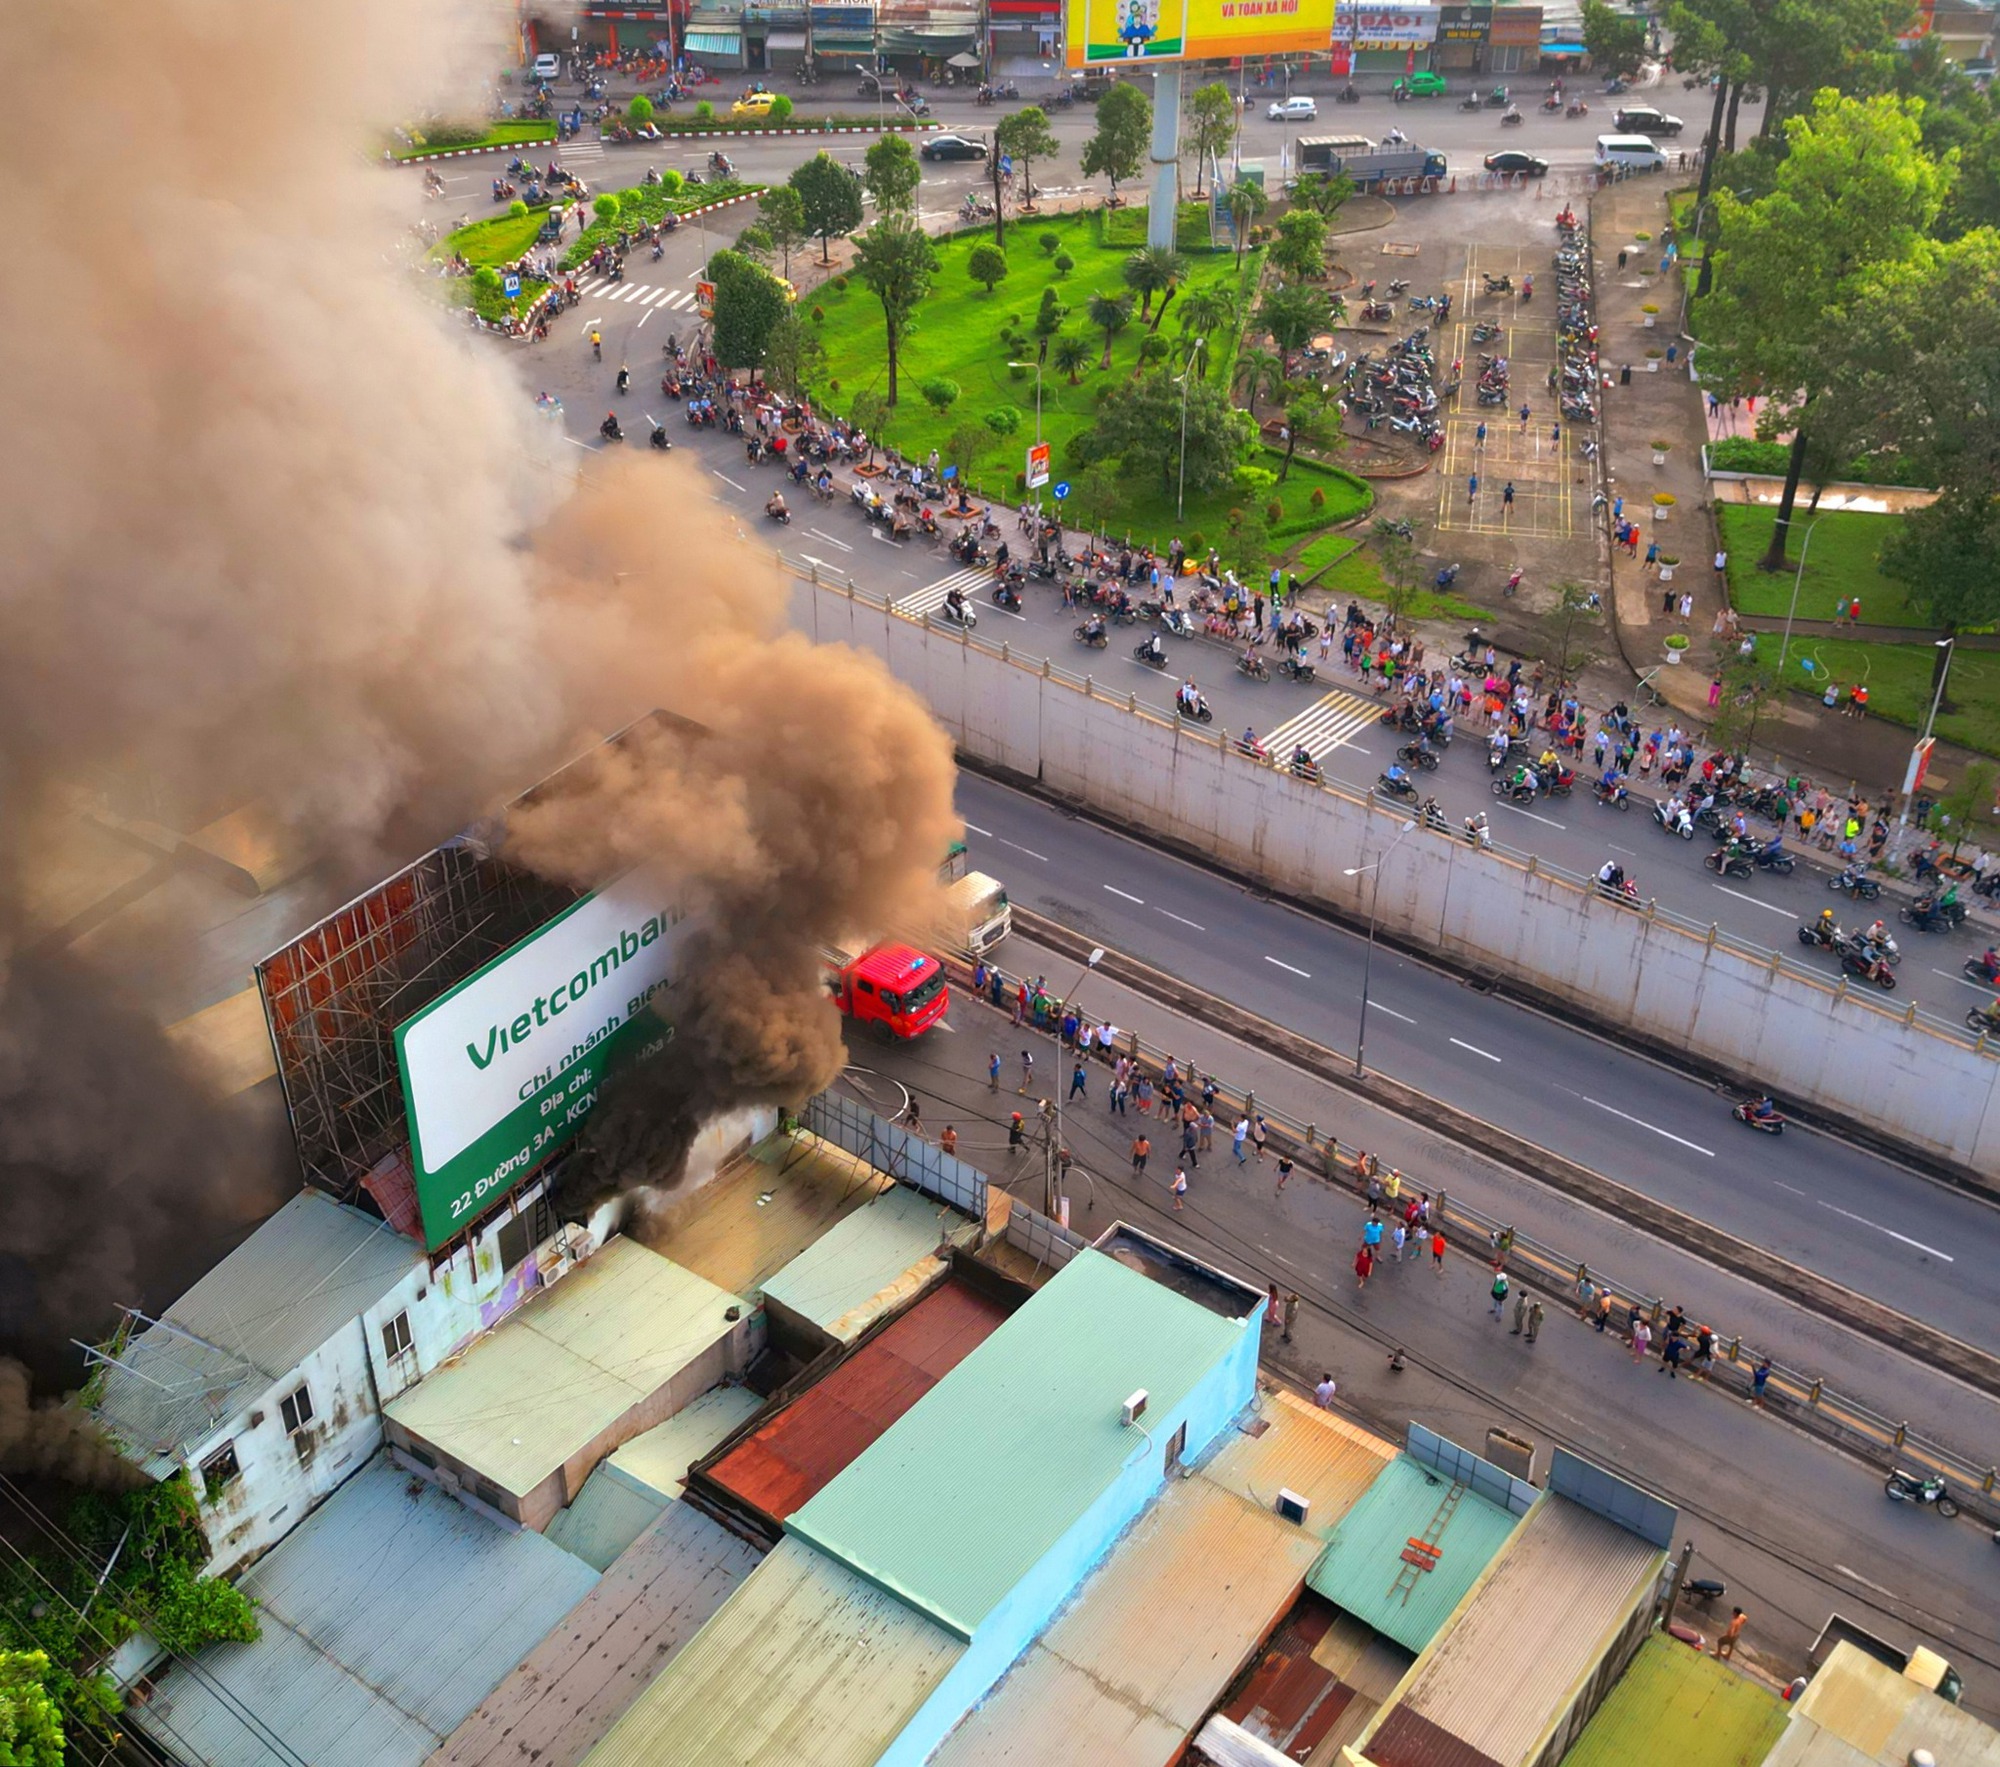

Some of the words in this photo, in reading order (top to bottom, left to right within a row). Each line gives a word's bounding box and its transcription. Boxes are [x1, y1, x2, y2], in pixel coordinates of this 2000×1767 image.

[466, 903, 686, 1071] Vietcomban
[518, 1065, 553, 1101] Chi
[559, 1015, 620, 1071] nhánh
[540, 1090, 565, 1117] Địa
[450, 1191, 473, 1219] 22
[474, 1145, 531, 1198] Đường
[533, 1125, 555, 1151] 3A
[566, 1087, 599, 1124] KCN
